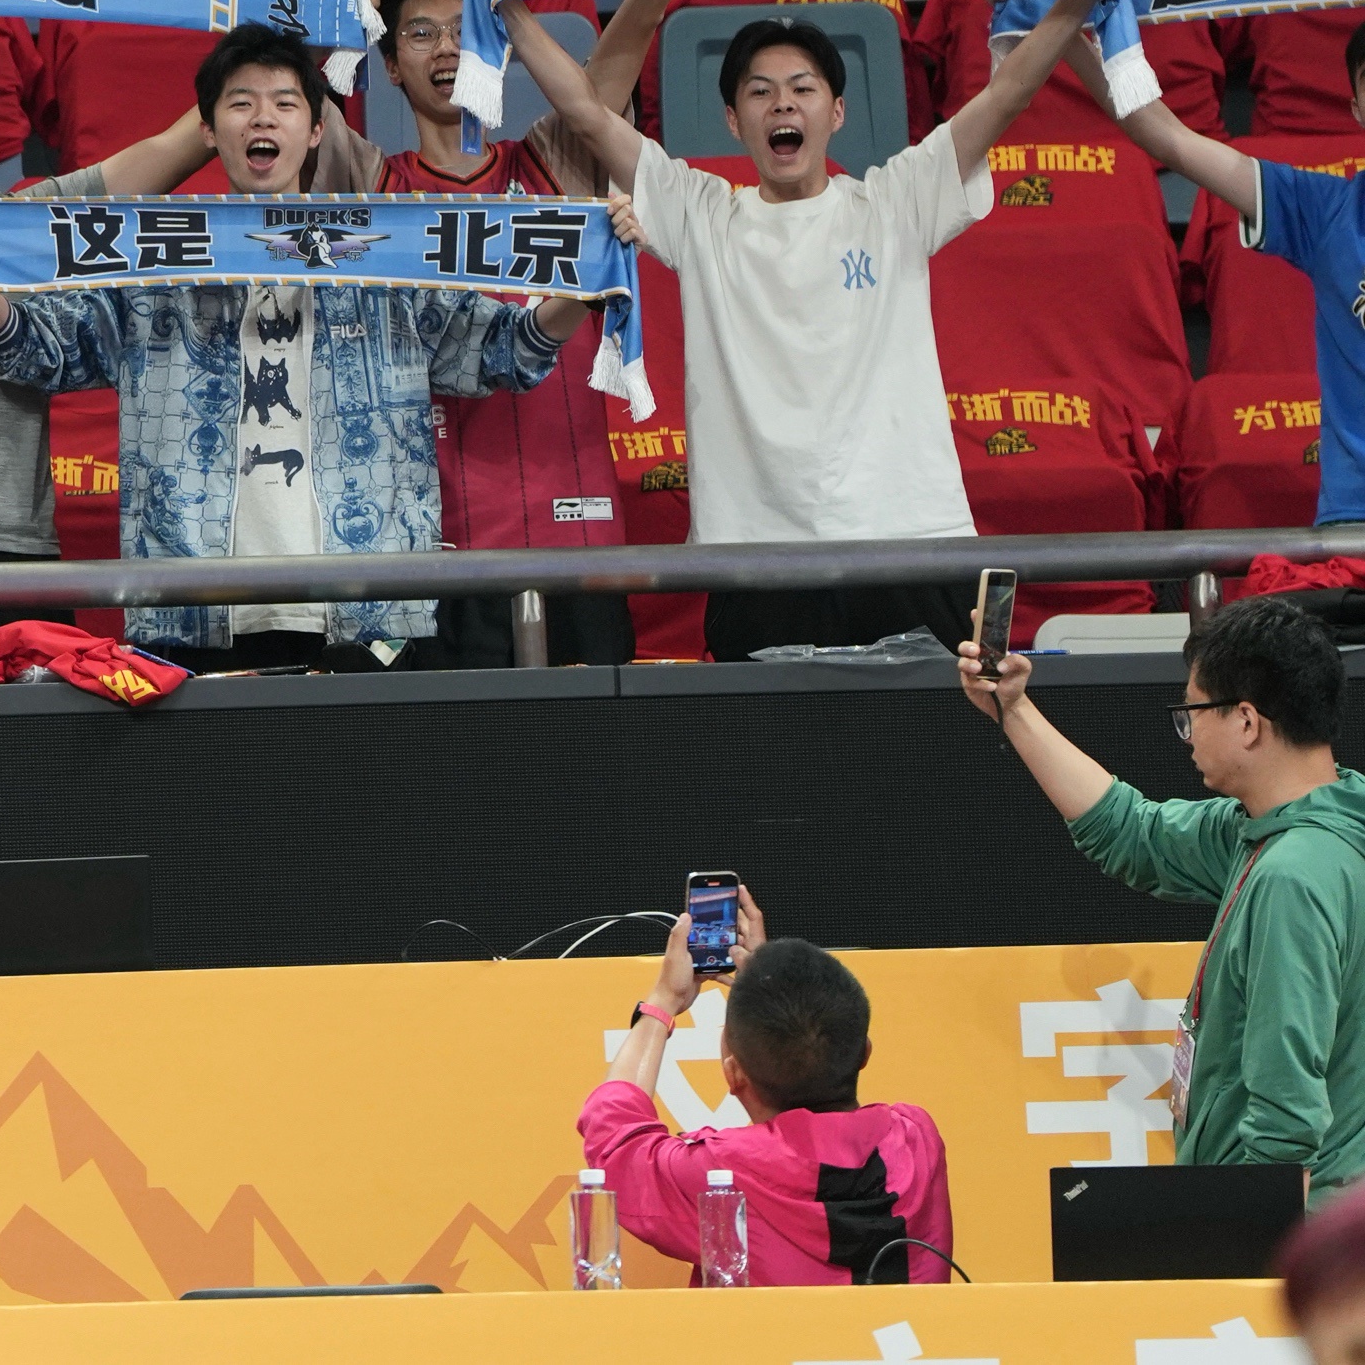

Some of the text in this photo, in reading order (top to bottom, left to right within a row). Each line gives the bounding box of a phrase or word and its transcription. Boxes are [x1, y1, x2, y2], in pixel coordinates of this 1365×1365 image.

[263, 205, 373, 230] DUCKS
[48, 204, 590, 287] 这是 北京
[329, 322, 368, 340] FILA
